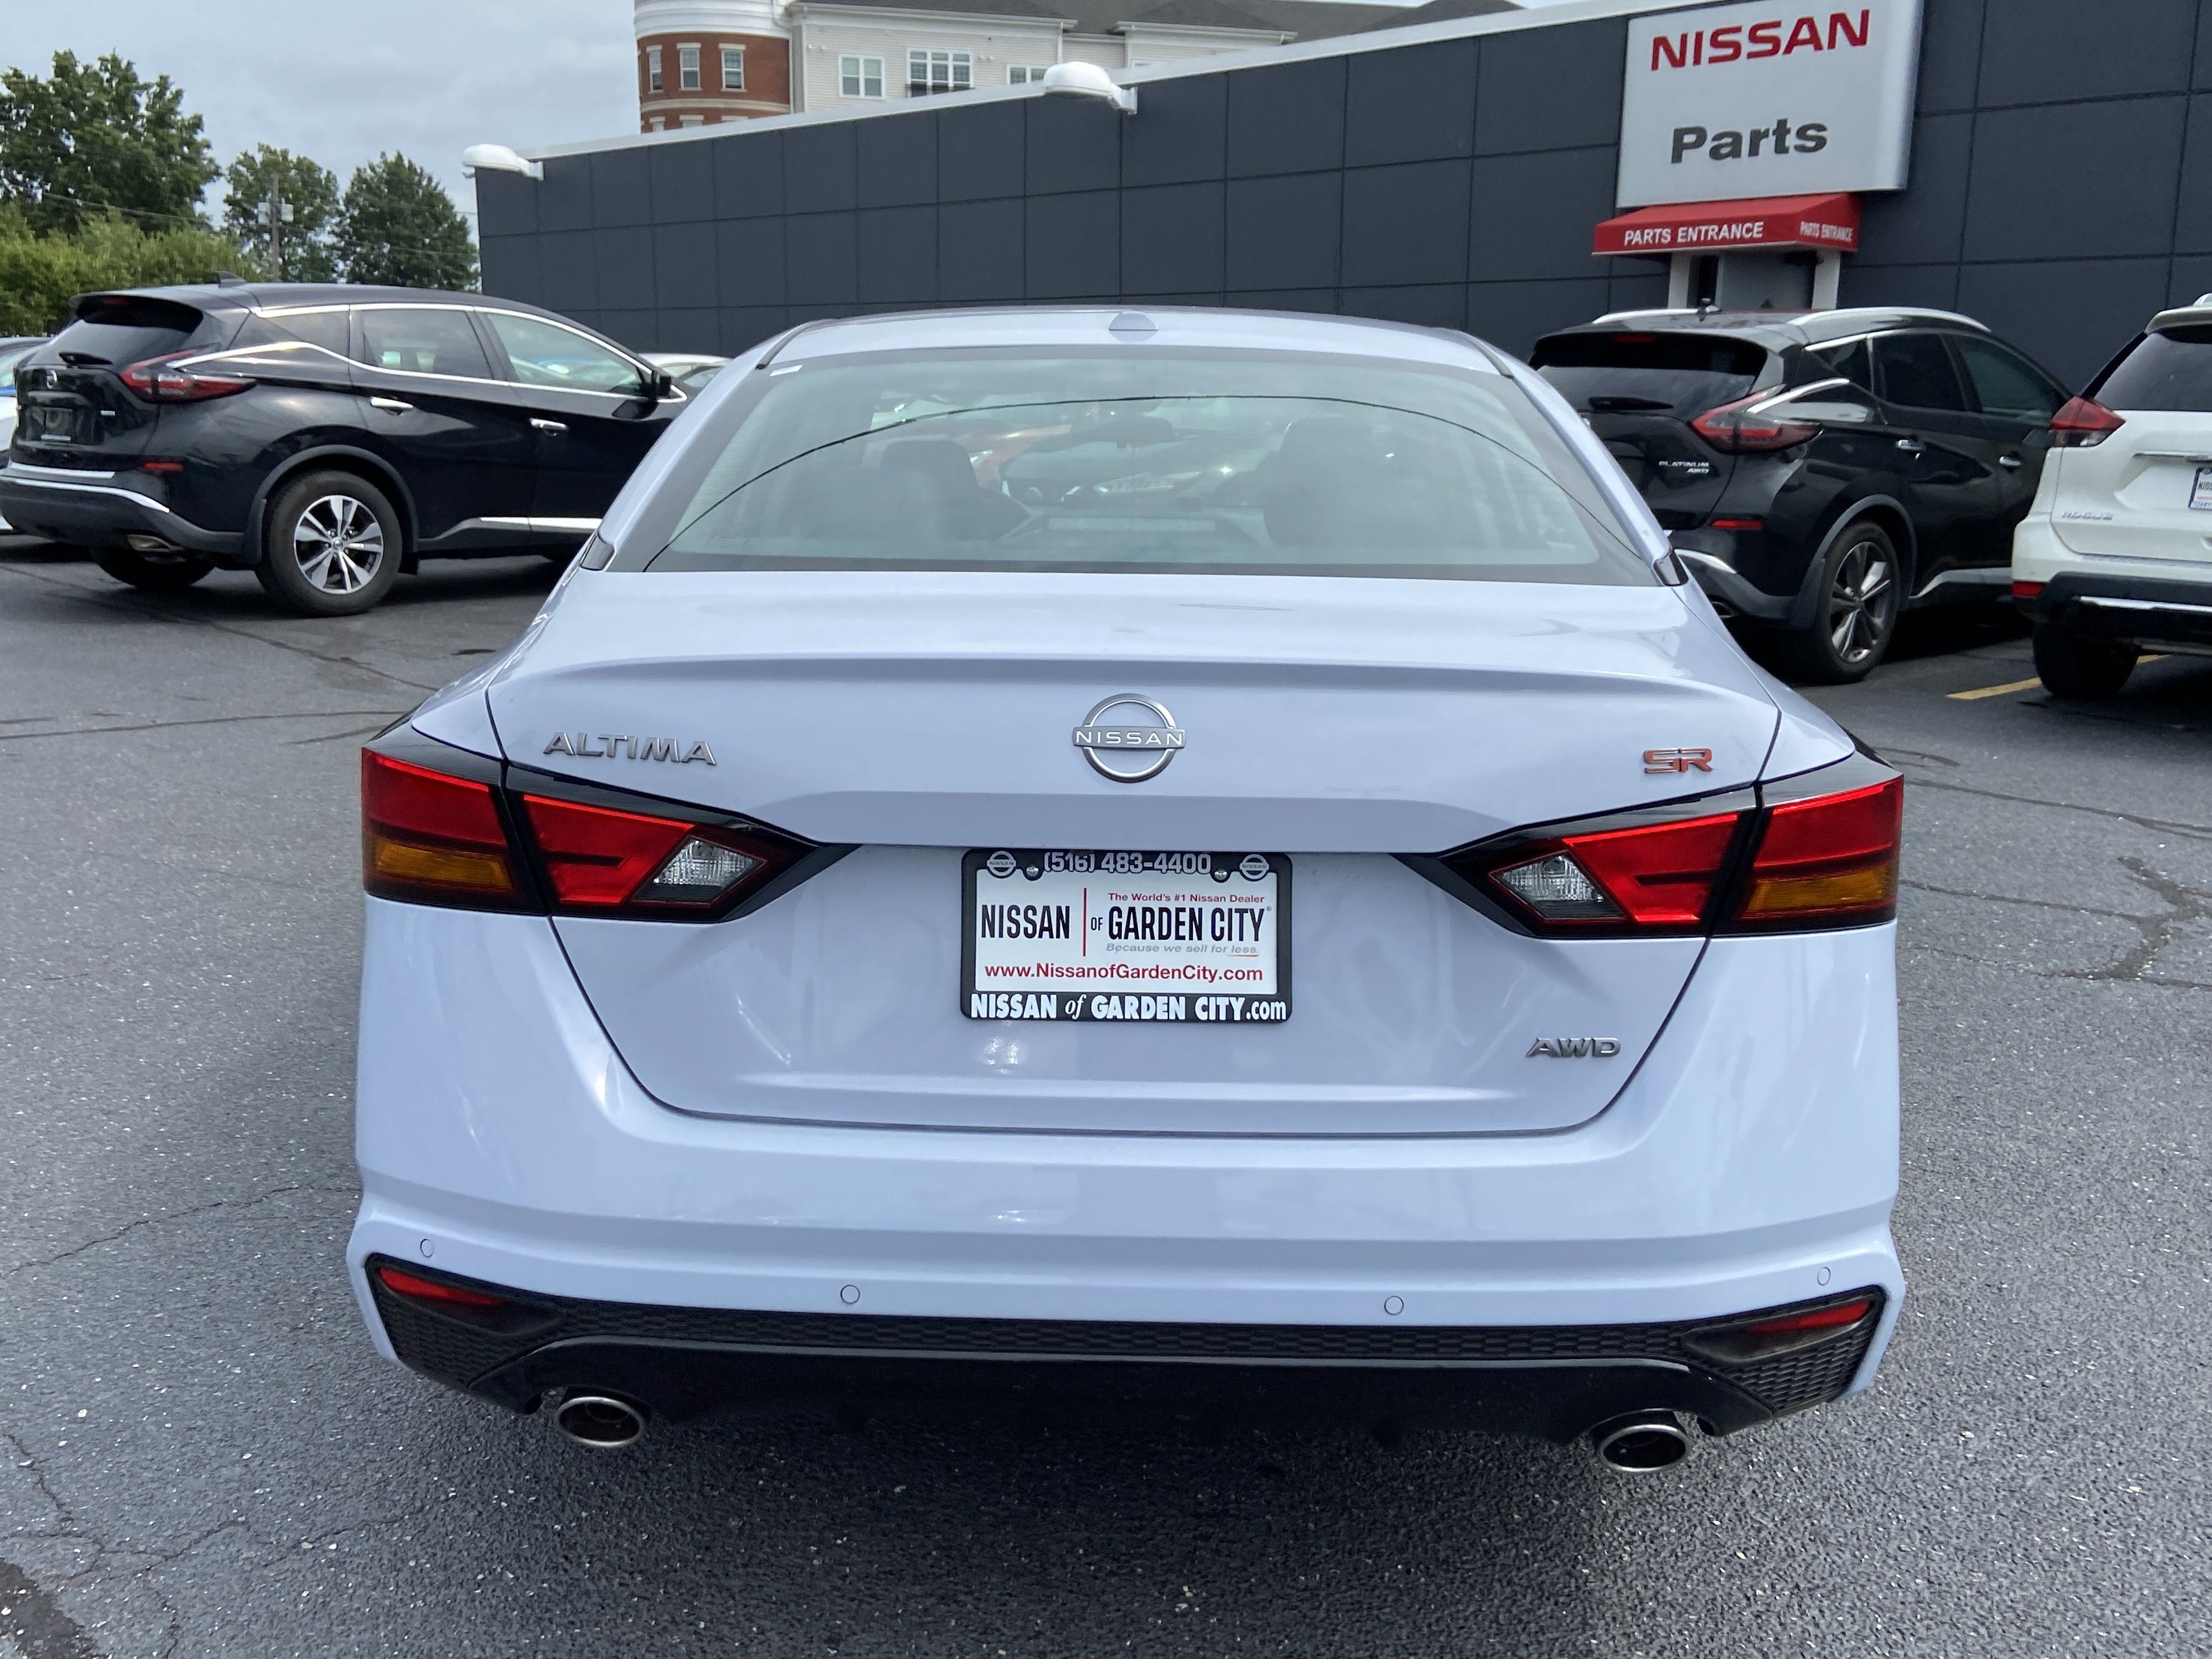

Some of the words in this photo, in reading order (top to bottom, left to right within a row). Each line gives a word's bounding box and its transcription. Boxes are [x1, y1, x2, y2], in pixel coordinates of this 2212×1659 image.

[1651, 9, 1870, 71] NISSAN
[1671, 117, 1829, 164] Parts
[1624, 227, 1672, 246] PARTS
[1677, 221, 1764, 243] ENTRANCE
[1800, 221, 1820, 238] PARTS
[543, 731, 717, 766] ALTIMA
[1076, 730, 1183, 746] NISSAN
[1643, 747, 1714, 774] SR
[1044, 851, 1095, 873] (516)
[1101, 852, 1211, 874] 483-4400
[1108, 893, 1128, 901] The
[1131, 893, 1171, 902] World's
[1175, 894, 1186, 902] #1
[1190, 894, 1226, 902] Nissan
[1229, 894, 1265, 903] Dealer
[981, 904, 1070, 939] NISSAN
[1090, 917, 1103, 931] OF
[1109, 906, 1203, 941] GARDEN
[1211, 907, 1265, 942] CITY
[1106, 943, 1159, 952] Because
[1186, 945, 1207, 953] sell
[1211, 945, 1228, 953] for
[1231, 945, 1259, 954] less.
[984, 963, 1263, 983] www.NissanofGardenCity.com
[970, 993, 1057, 1019] NISSAN
[1065, 994, 1087, 1020] of
[1091, 994, 1186, 1020] GARDEN
[1526, 1037, 1621, 1057] AWD
